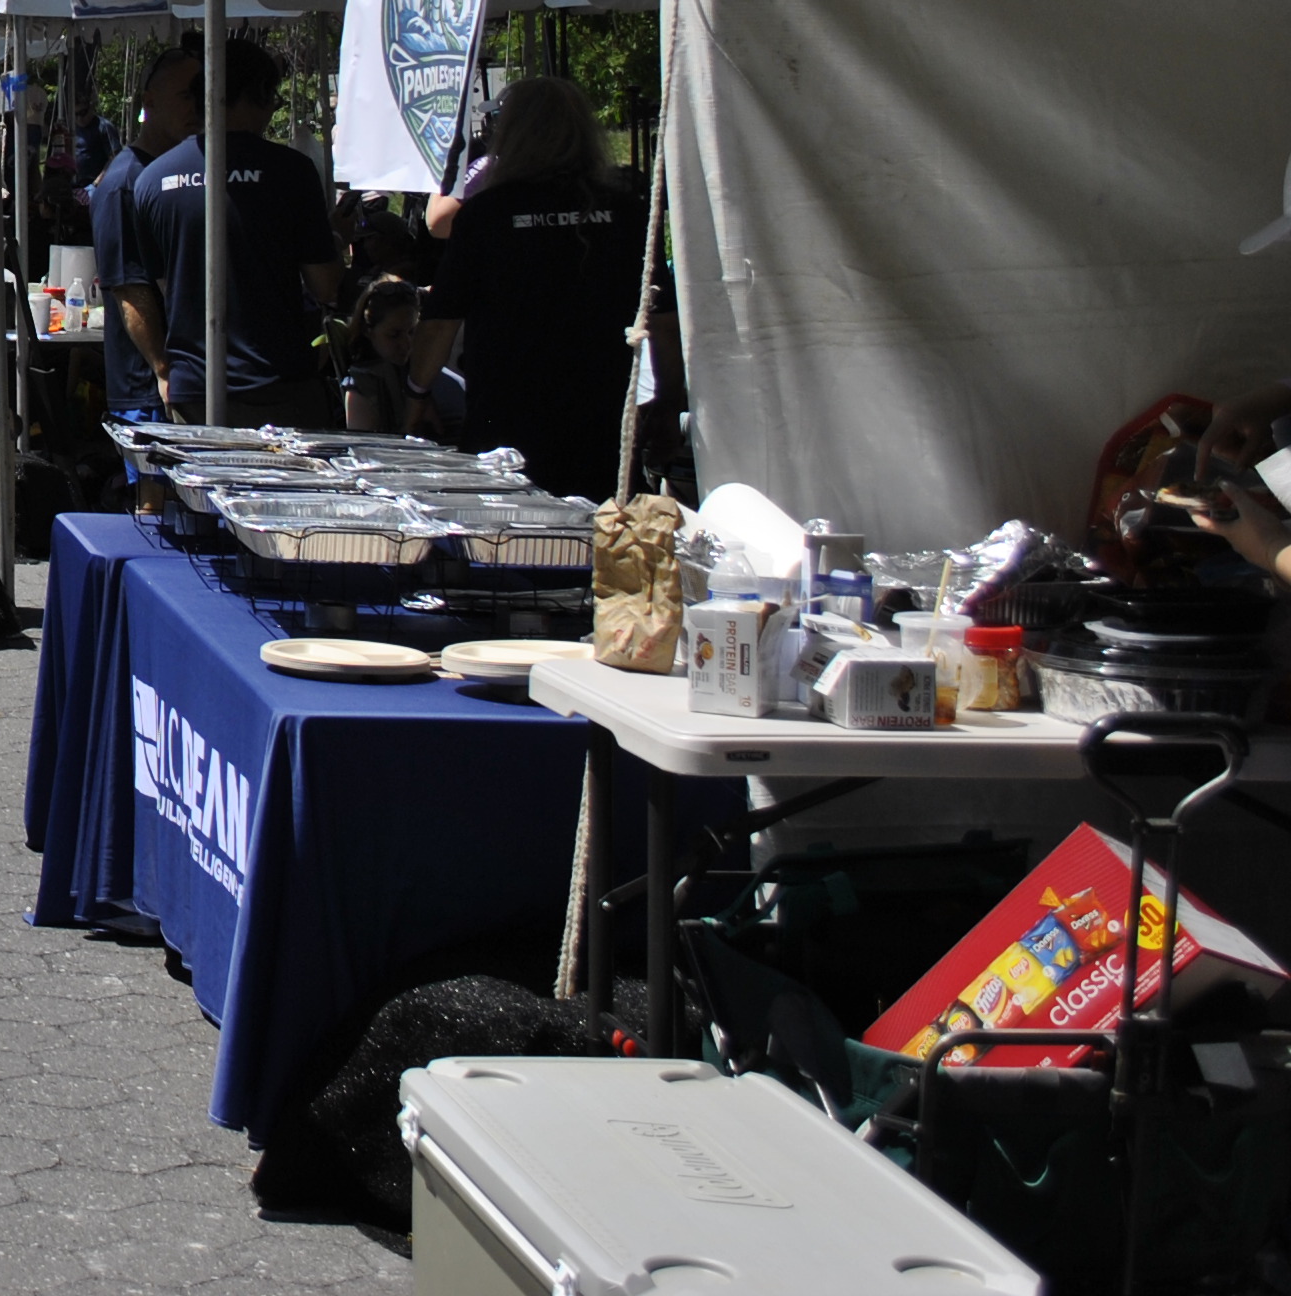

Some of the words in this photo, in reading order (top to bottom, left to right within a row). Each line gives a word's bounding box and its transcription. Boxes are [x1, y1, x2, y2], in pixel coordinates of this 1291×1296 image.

[403, 65, 448, 104] PADDLES
[725, 620, 736, 671] PROTEIN
[725, 672, 736, 696] BAR
[741, 696, 751, 708] 10
[850, 715, 876, 728] BAR
[877, 715, 931, 728] PROTEIN
[1070, 909, 1099, 931] Doritos
[1032, 926, 1060, 954] Doritos
[1049, 953, 1125, 1026] classic
